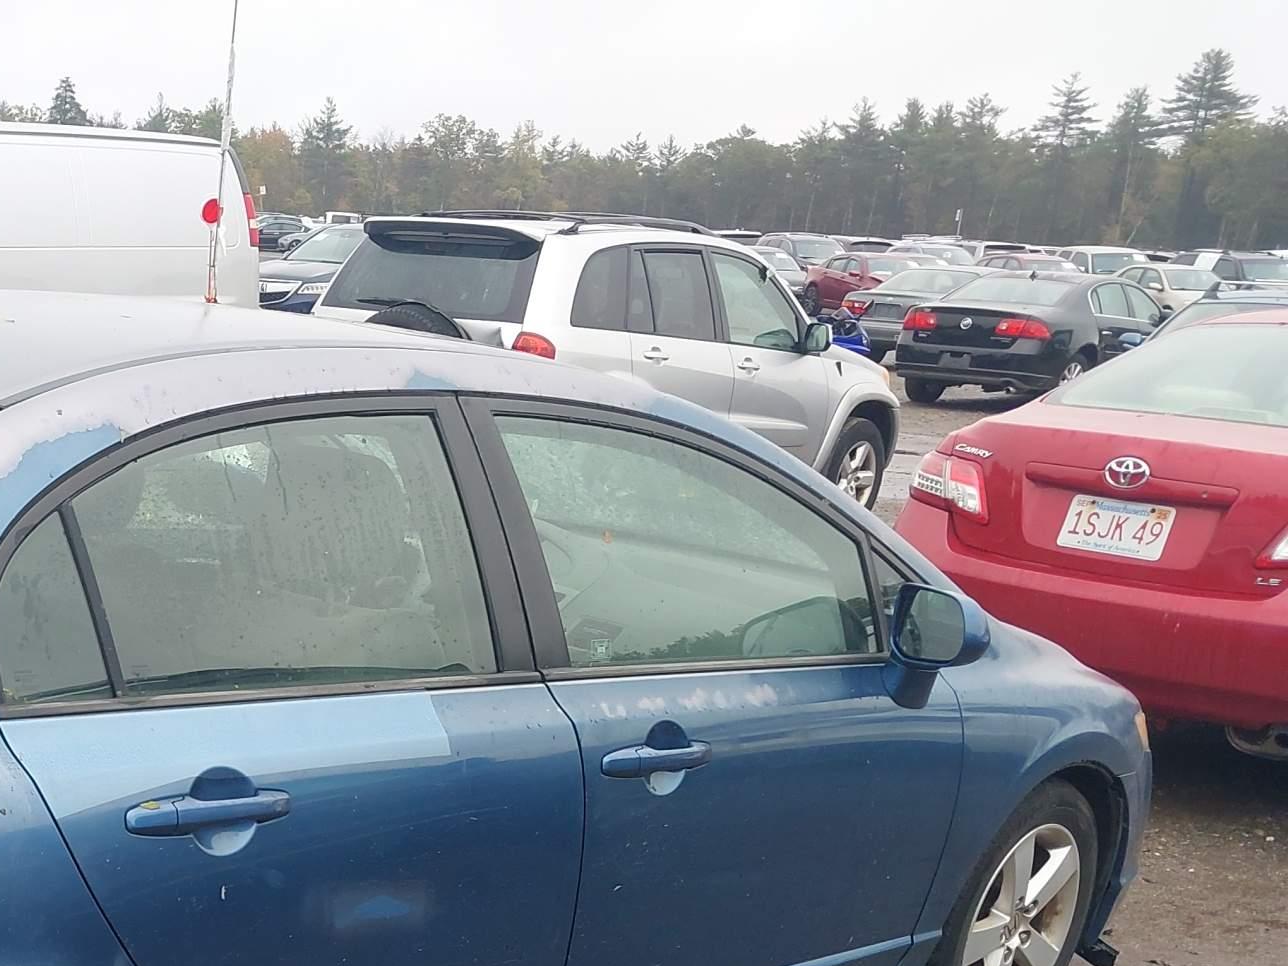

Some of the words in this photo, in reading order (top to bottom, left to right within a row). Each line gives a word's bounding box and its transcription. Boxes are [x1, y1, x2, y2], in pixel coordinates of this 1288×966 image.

[1068, 510, 1130, 542] 1SJK
[1132, 519, 1164, 546] 49
[1255, 577, 1282, 586] LE
